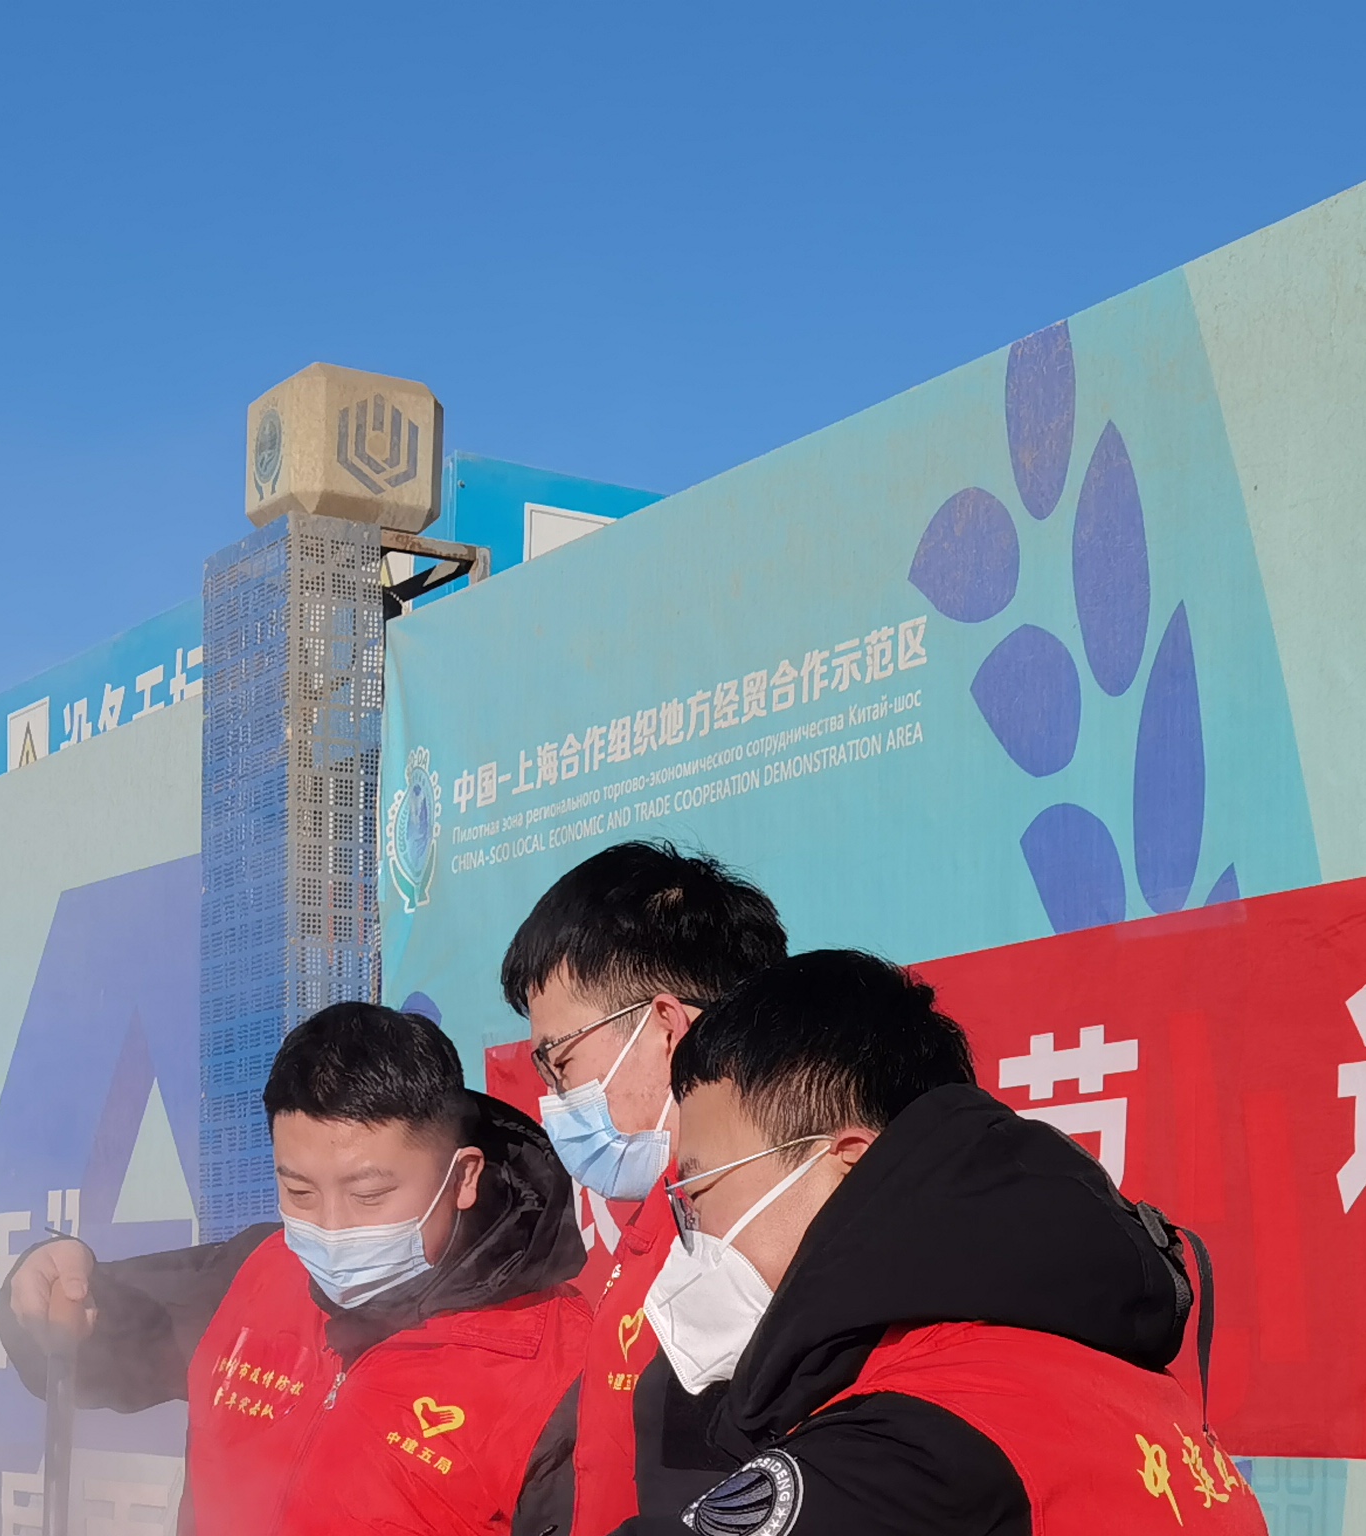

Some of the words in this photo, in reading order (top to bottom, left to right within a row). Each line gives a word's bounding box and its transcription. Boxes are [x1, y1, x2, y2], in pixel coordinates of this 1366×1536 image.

[450, 842, 509, 874] CHINA-SCO
[512, 832, 546, 857] LOCAL
[548, 812, 604, 848] ECONOMIC
[607, 805, 632, 830] AND
[634, 794, 671, 822] TRADE
[673, 770, 760, 812] COOPERATION
[763, 732, 882, 787] DEMONSTRATION
[885, 721, 924, 753] AREA
[501, 814, 524, 832] зона
[525, 788, 600, 829] регионального
[745, 713, 844, 758] сотрудничества
[999, 1024, 1139, 1190] 节
[386, 1431, 452, 1475] 中建五局
